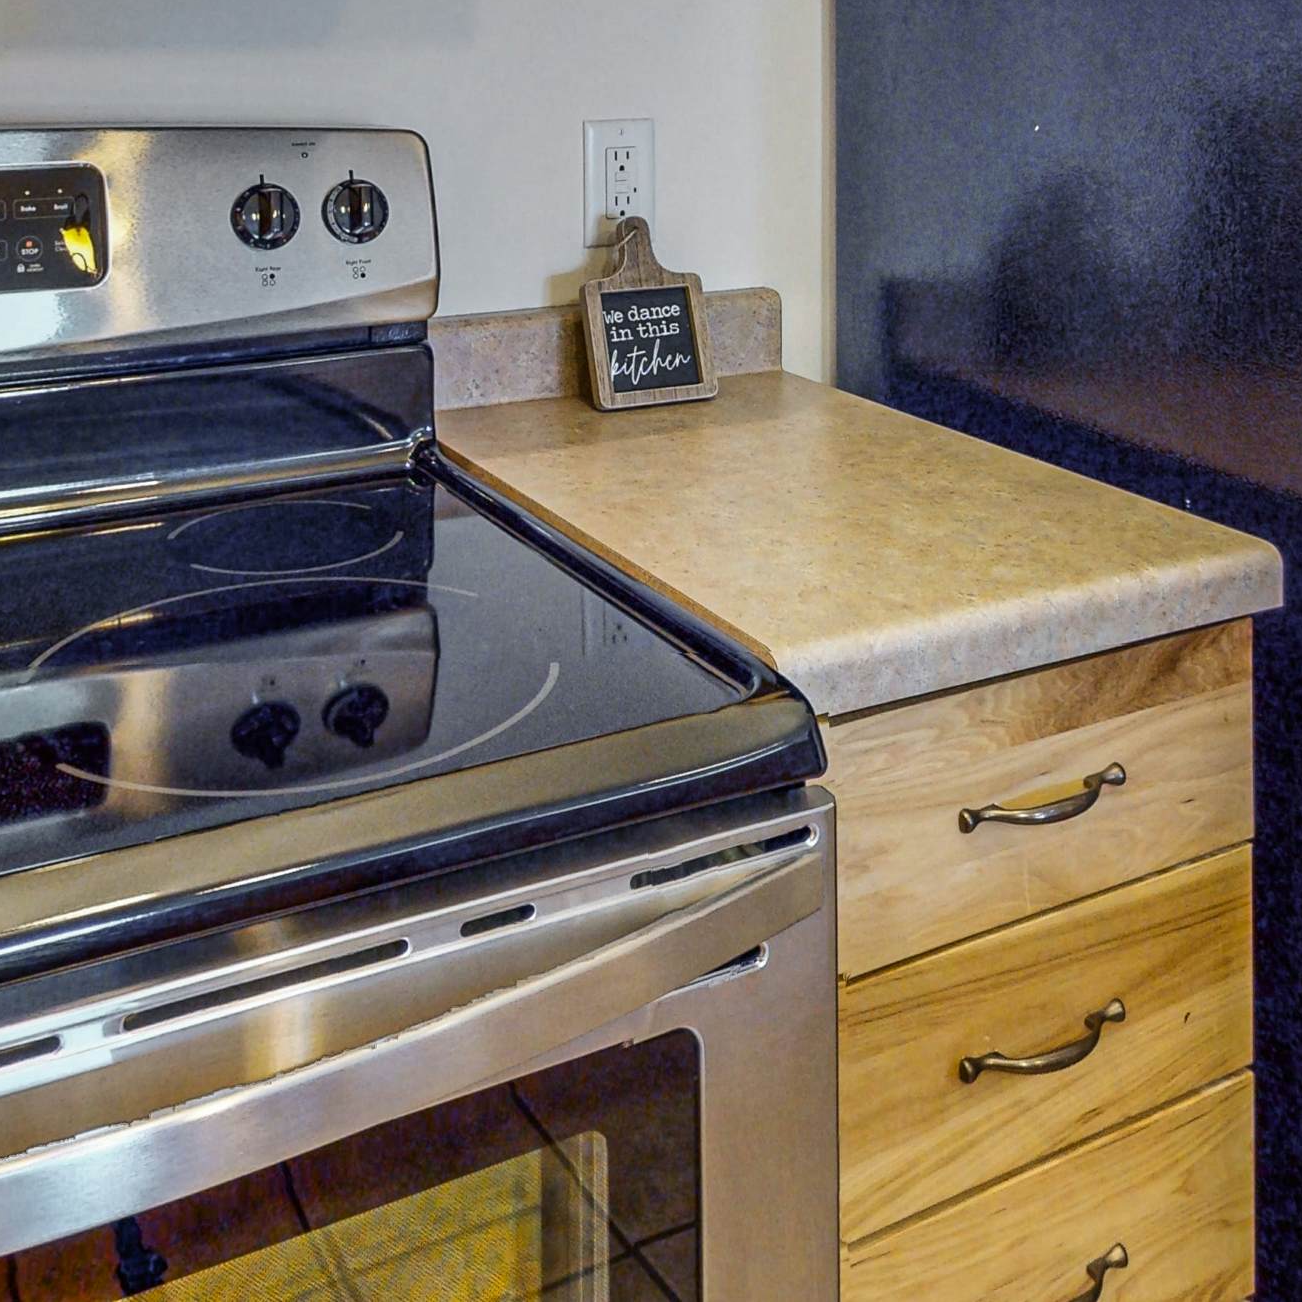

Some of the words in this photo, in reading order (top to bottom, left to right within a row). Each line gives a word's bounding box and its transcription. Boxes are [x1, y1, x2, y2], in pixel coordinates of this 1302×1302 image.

[628, 303, 681, 322] dance
[610, 326, 634, 342] in
[638, 320, 680, 339] this
[610, 338, 692, 385] kitchen
